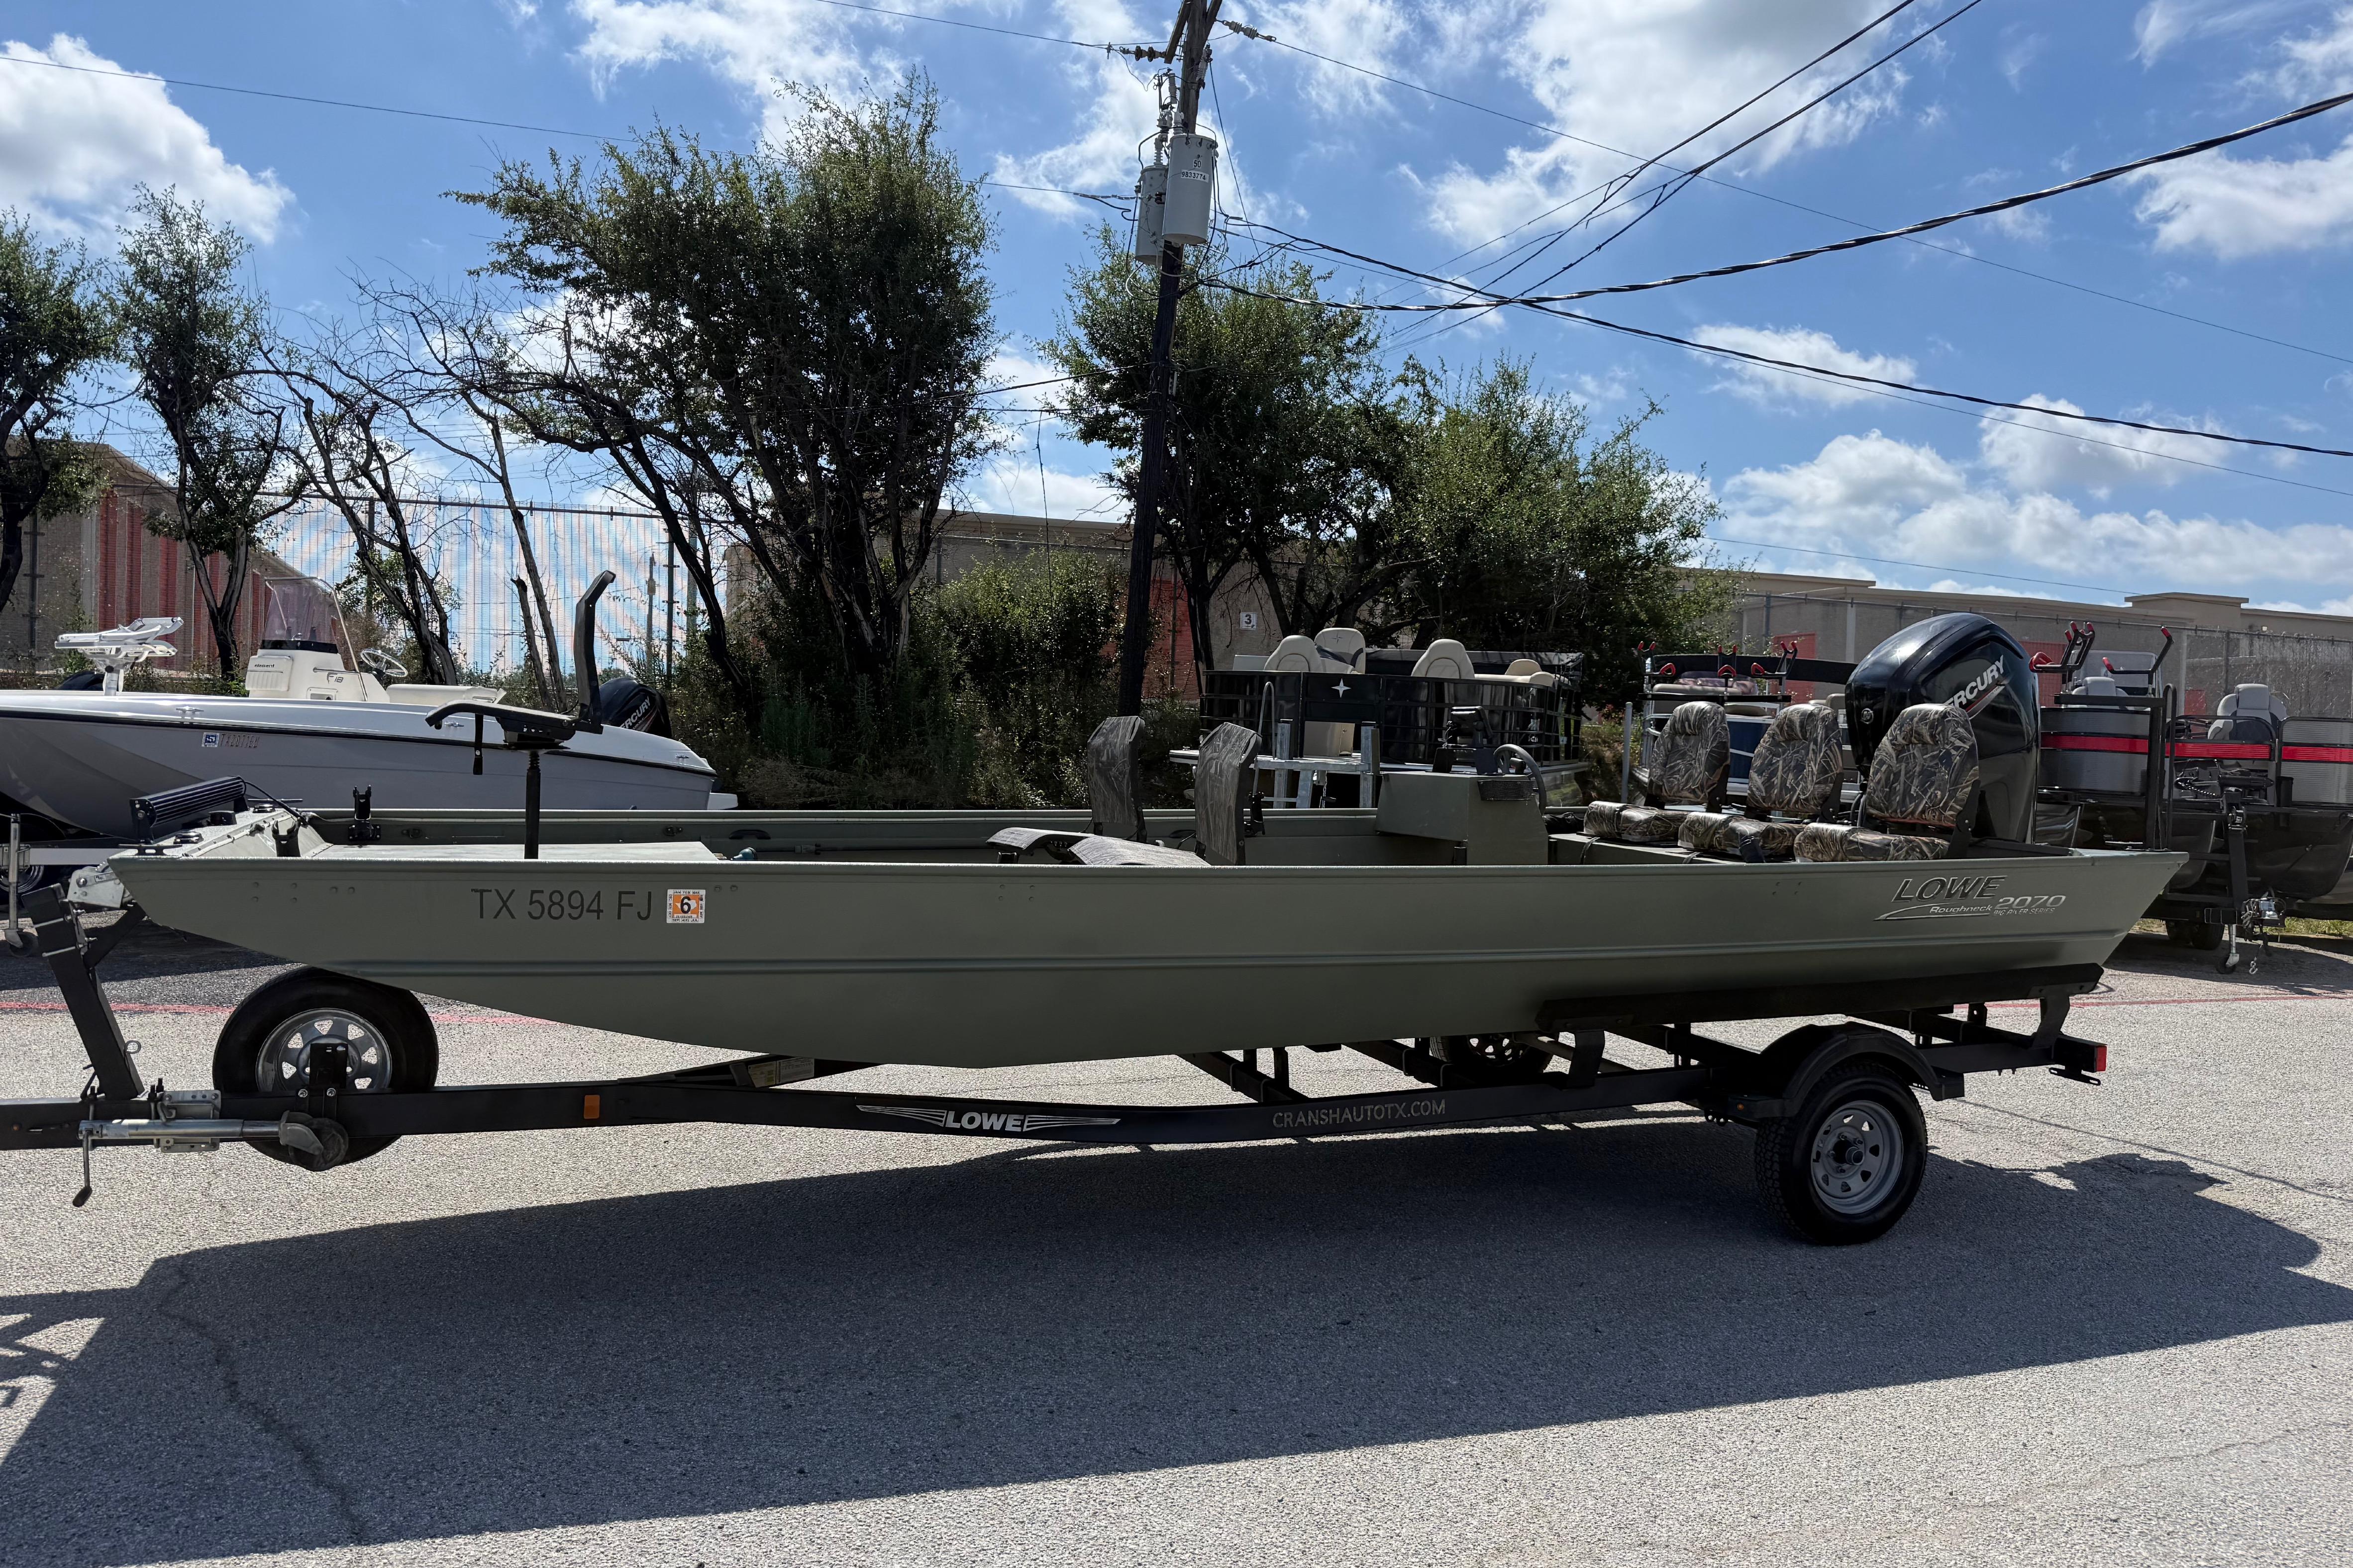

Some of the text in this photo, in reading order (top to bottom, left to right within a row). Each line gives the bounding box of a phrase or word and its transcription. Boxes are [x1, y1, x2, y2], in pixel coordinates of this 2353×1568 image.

[1181, 171, 1206, 180] 9833774
[1245, 614, 1252, 625] 3
[1943, 655, 2004, 708] RCURY
[619, 696, 650, 729] RCURY
[1891, 875, 2008, 902] LOWE
[471, 888, 516, 919] TX
[527, 889, 604, 920] 5894
[617, 890, 652, 920] FJ
[680, 896, 691, 914] 6
[1930, 904, 1993, 914] Roughneck
[1994, 895, 2066, 909] 2070
[945, 1111, 1024, 1132] LOWE
[1272, 1099, 1446, 1128] CRANSHAUTOTX.COM
